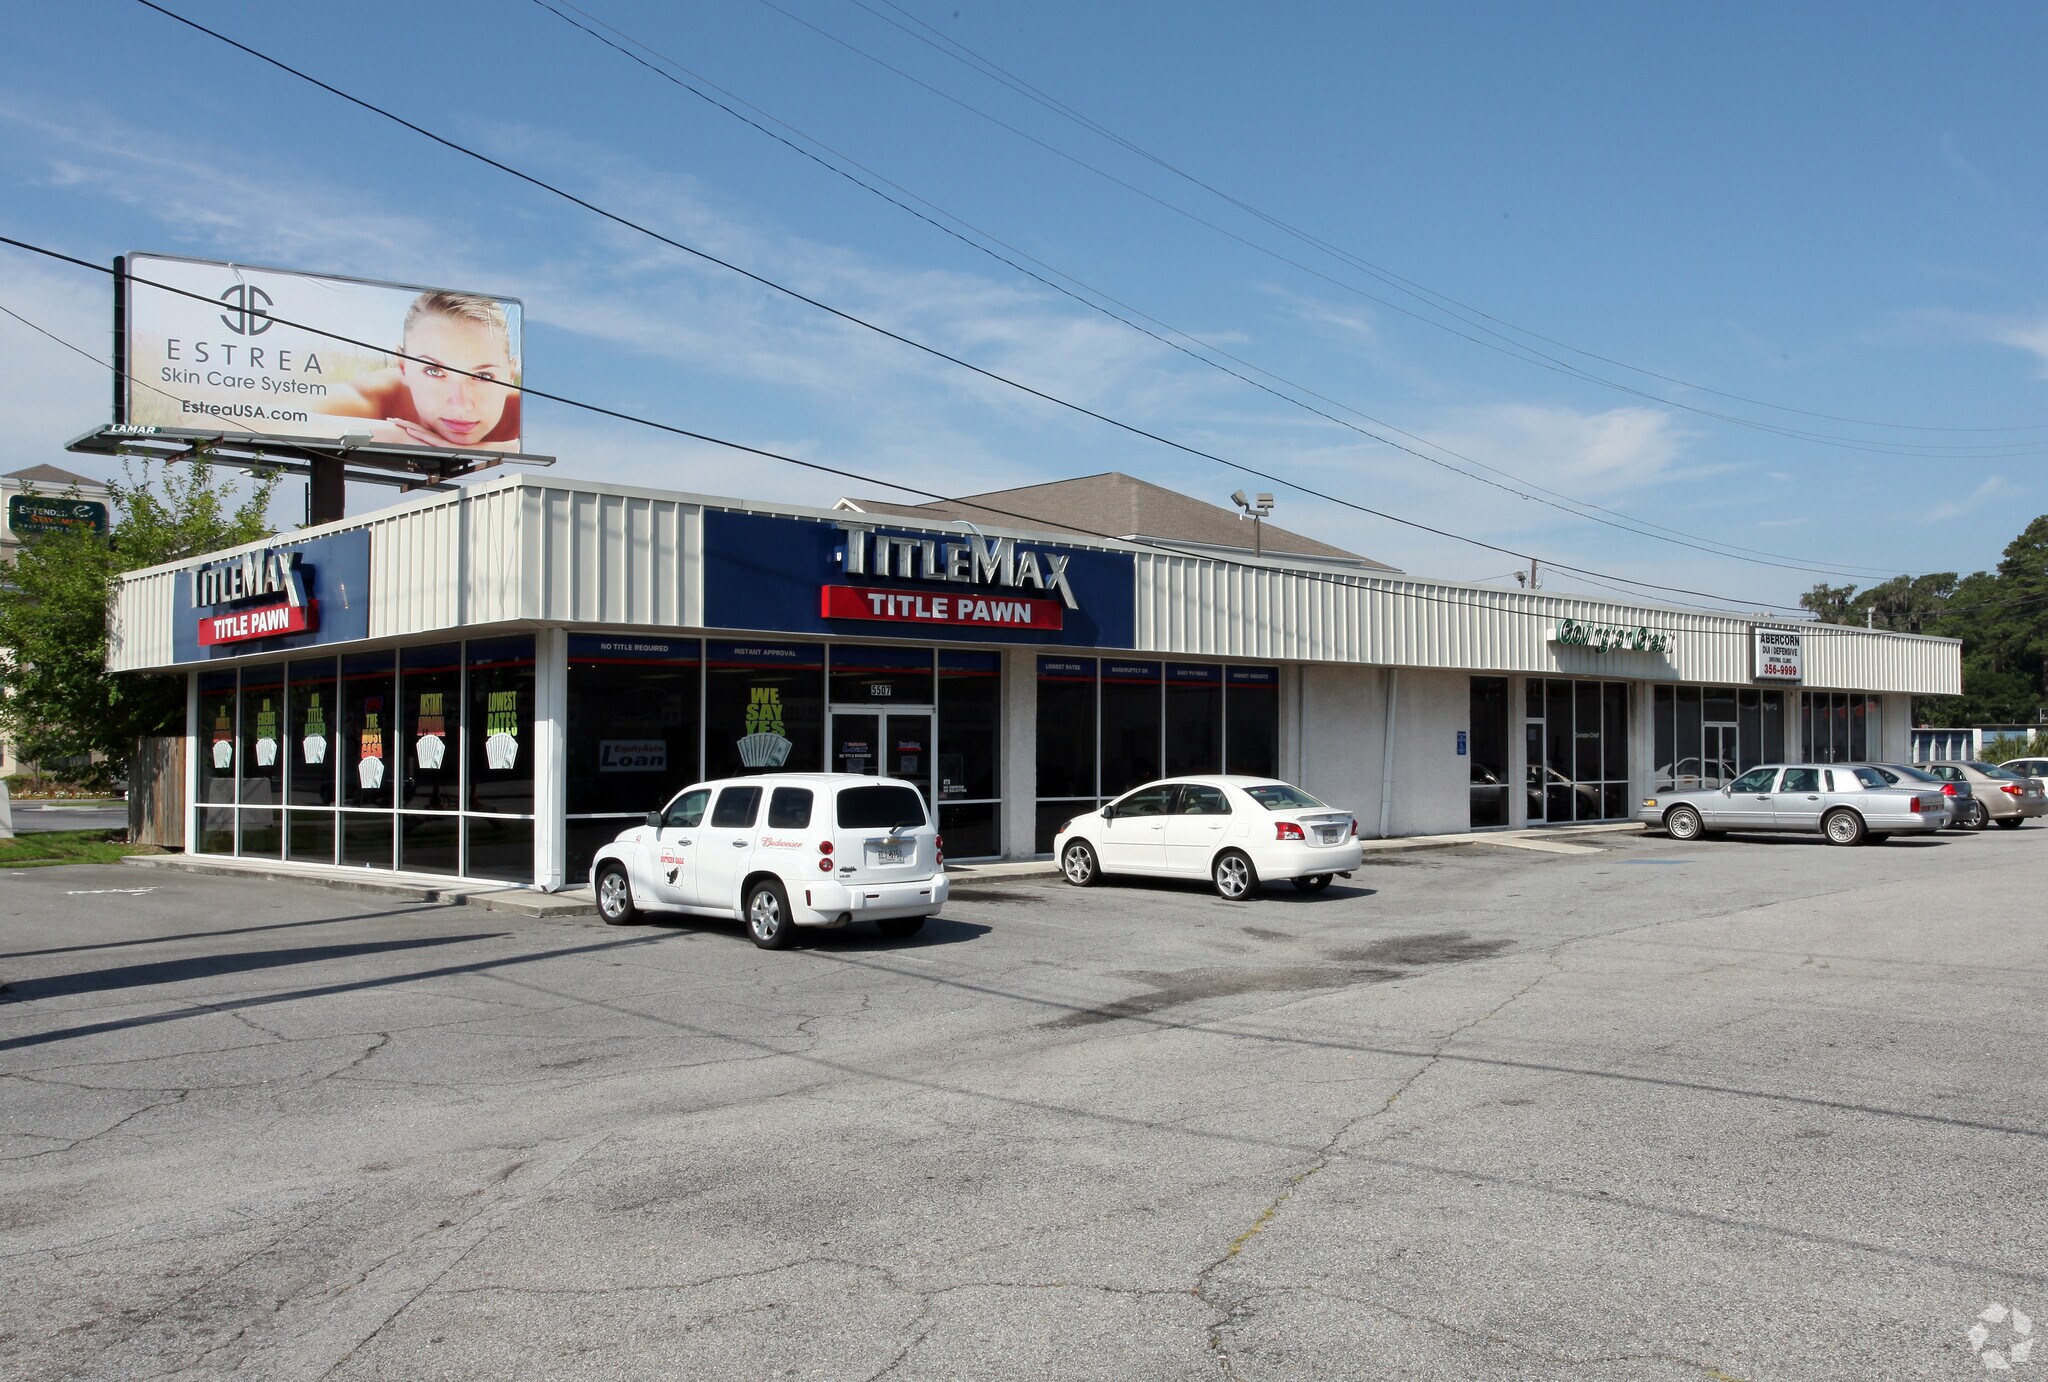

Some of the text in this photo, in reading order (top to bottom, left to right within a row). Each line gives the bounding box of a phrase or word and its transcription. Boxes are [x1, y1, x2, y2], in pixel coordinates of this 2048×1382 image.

[167, 338, 323, 375] ESTREA
[161, 366, 327, 396] Skin Care System
[182, 400, 308, 423] EstreaUSA.com
[111, 424, 156, 434] LAMAR
[868, 593, 1031, 624] TITLE PAWN
[213, 607, 289, 640] TITLE PAWN
[613, 643, 633, 651] TITLE
[634, 644, 669, 652] REQUIRED
[1760, 632, 1800, 646] ABERCORN
[734, 648, 796, 657] INSTANT APPROVAL
[1764, 664, 1797, 676] 356-9999
[750, 687, 780, 704] WE
[871, 685, 892, 696] 5507
[488, 691, 517, 712] LOWEST
[307, 707, 323, 723] TITLE
[745, 704, 784, 721] SAY
[487, 711, 518, 737] RATES
[745, 720, 786, 737] YES
[601, 745, 664, 767] Loan
[761, 837, 803, 848] Budweiser
